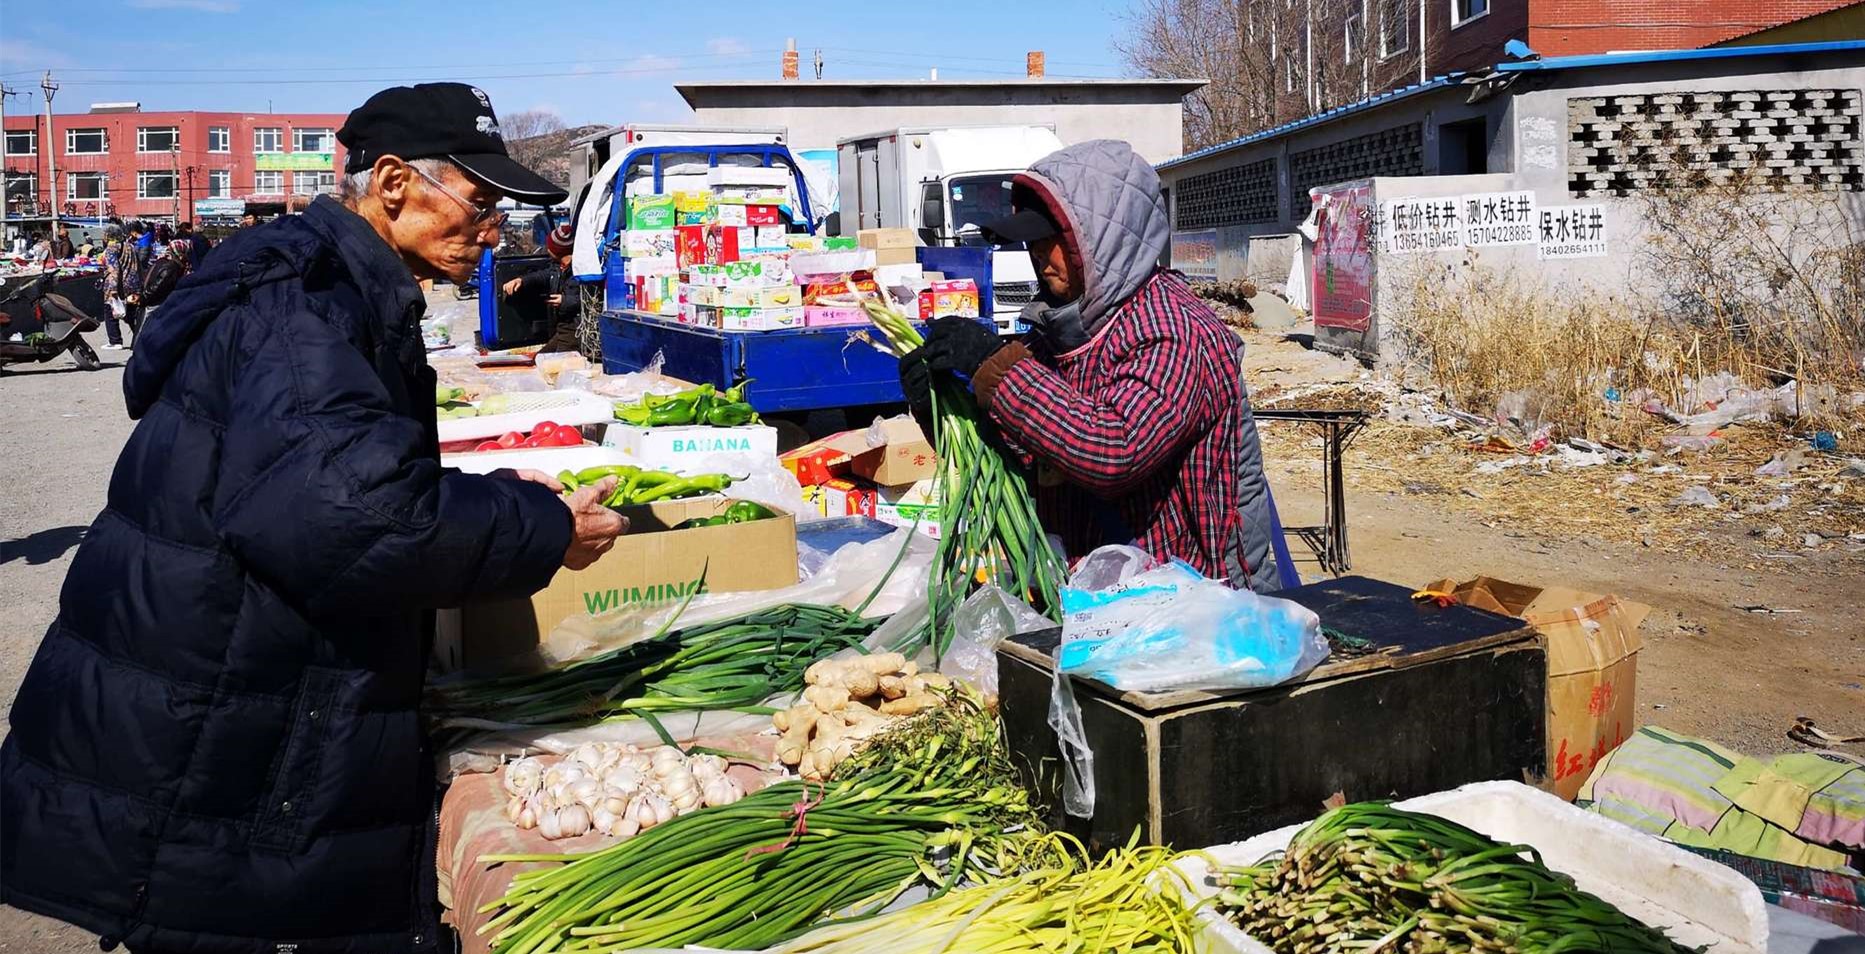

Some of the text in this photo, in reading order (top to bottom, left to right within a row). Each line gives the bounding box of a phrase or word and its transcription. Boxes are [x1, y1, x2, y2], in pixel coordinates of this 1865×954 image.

[1393, 201, 1456, 231] 低价钻井
[1467, 195, 1531, 225] 测水钻井
[1468, 225, 1532, 244] 15704228885
[1539, 208, 1603, 243] 保水钻井
[1394, 230, 1458, 250] 13654160465
[1541, 243, 1605, 255] 18402654111
[673, 438, 750, 452] BANANA
